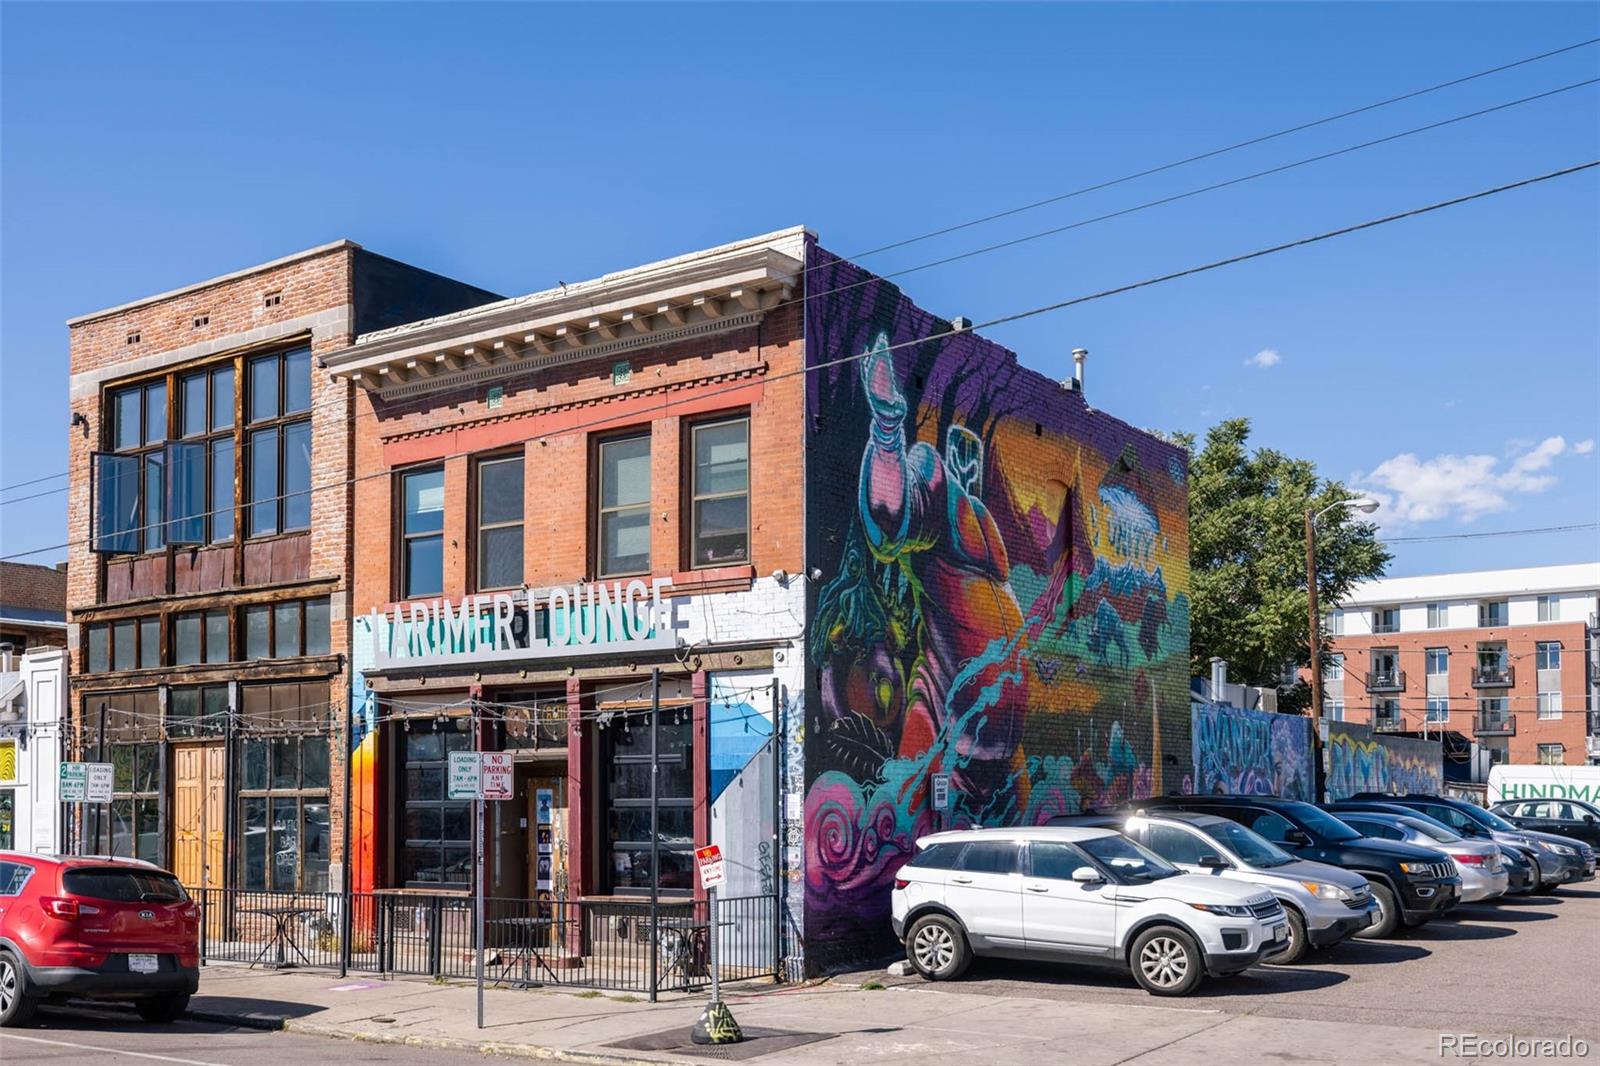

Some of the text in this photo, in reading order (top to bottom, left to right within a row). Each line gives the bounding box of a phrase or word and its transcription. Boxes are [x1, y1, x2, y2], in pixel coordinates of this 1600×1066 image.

[371, 577, 672, 660] LARIMER LOUNGE
[453, 756, 477, 764] LOADING
[491, 755, 503, 765] NO
[61, 764, 67, 778] 2
[483, 765, 512, 775] PARKING
